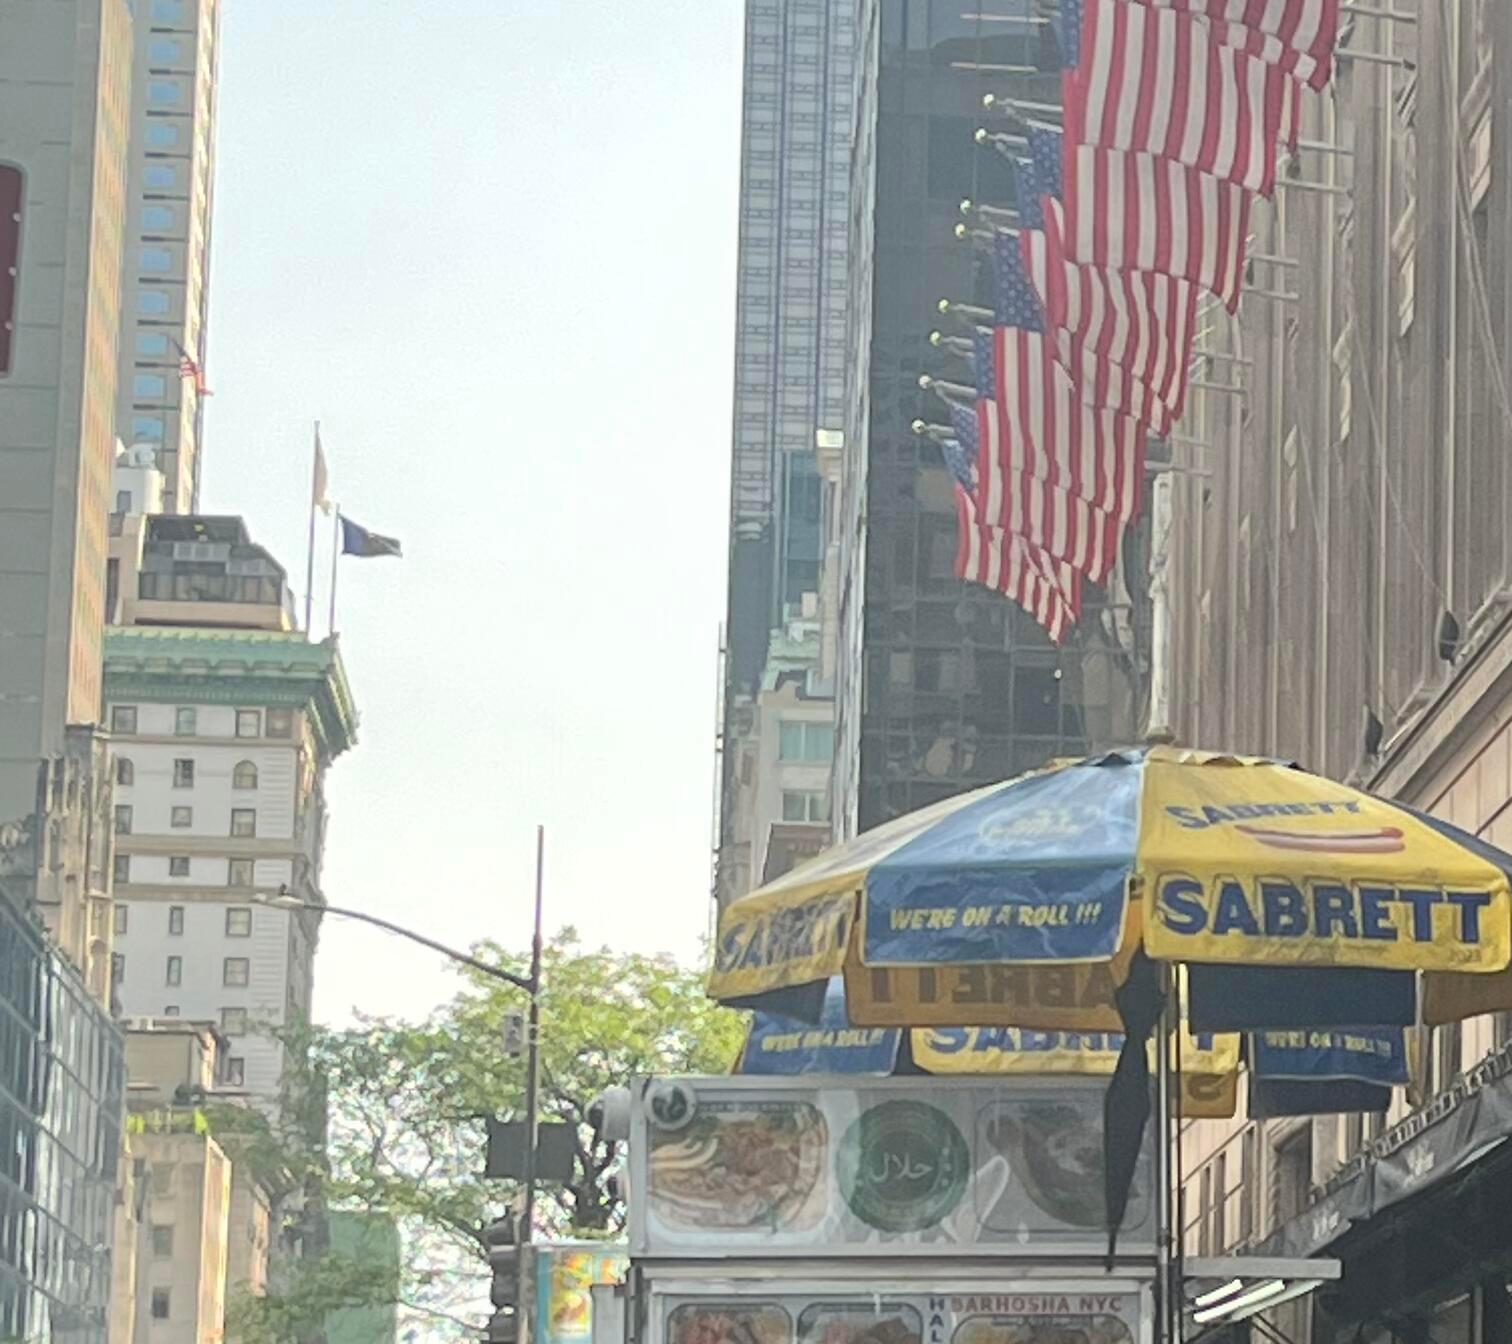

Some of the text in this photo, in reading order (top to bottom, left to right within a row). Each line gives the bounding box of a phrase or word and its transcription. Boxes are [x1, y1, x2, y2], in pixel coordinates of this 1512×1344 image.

[1165, 800, 1361, 830] SABRETT
[890, 904, 956, 931] WE'RE
[961, 905, 992, 927] ON
[996, 905, 1011, 924] A
[1018, 903, 1069, 928] ROLL
[1157, 874, 1491, 945] SABRETT
[1081, 1296, 1122, 1313] NYC
